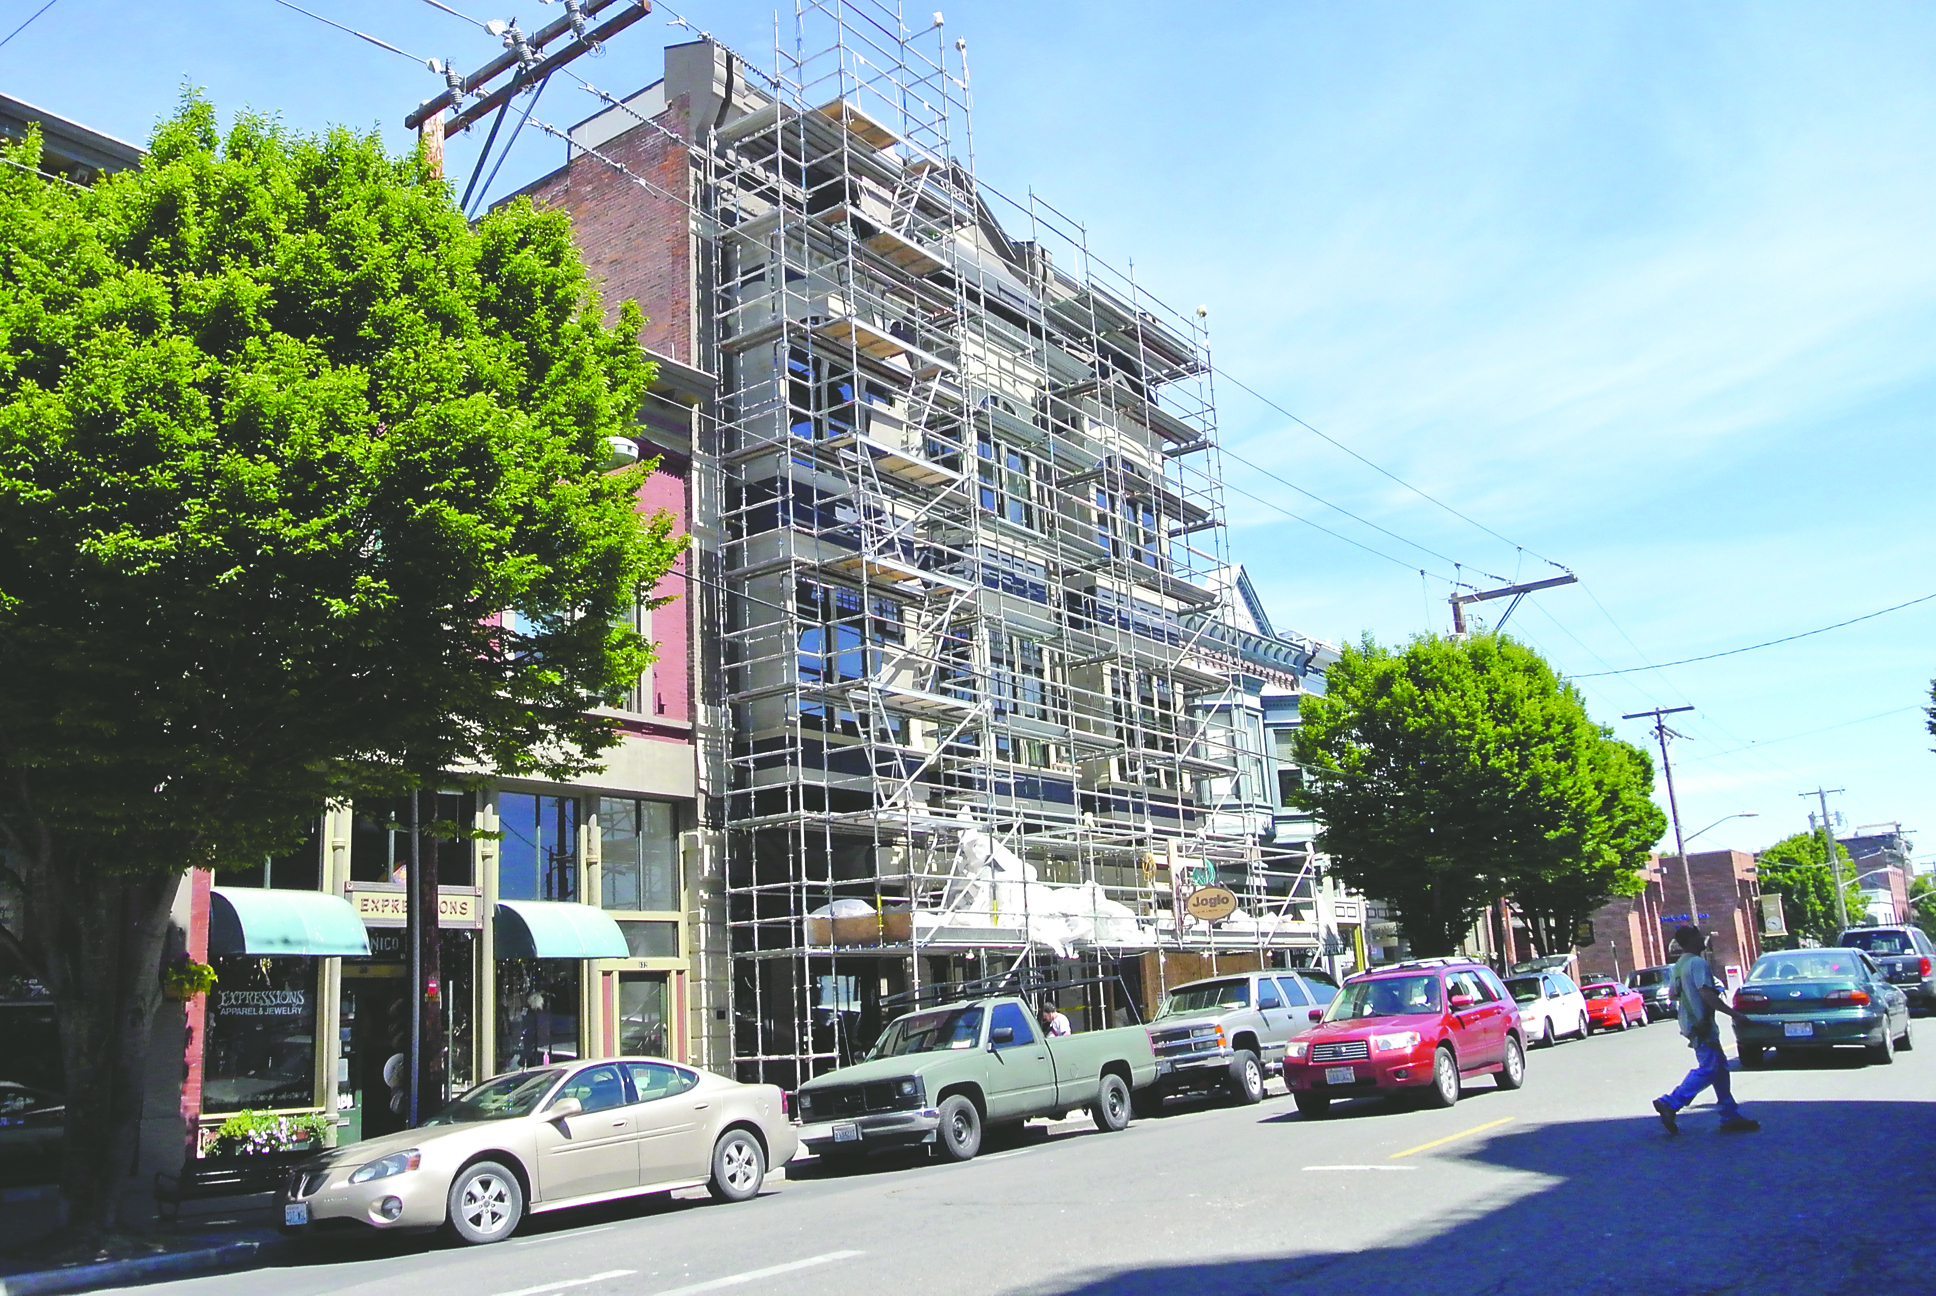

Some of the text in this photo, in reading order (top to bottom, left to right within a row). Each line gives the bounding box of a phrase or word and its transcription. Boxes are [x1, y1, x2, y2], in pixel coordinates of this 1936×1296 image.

[360, 898, 468, 915] EXPREONS
[1192, 894, 1229, 907] Joglo
[218, 990, 305, 1008] EXPRESSIONS
[219, 1006, 258, 1016] APPAREL
[264, 1006, 303, 1016] JEWELRY
